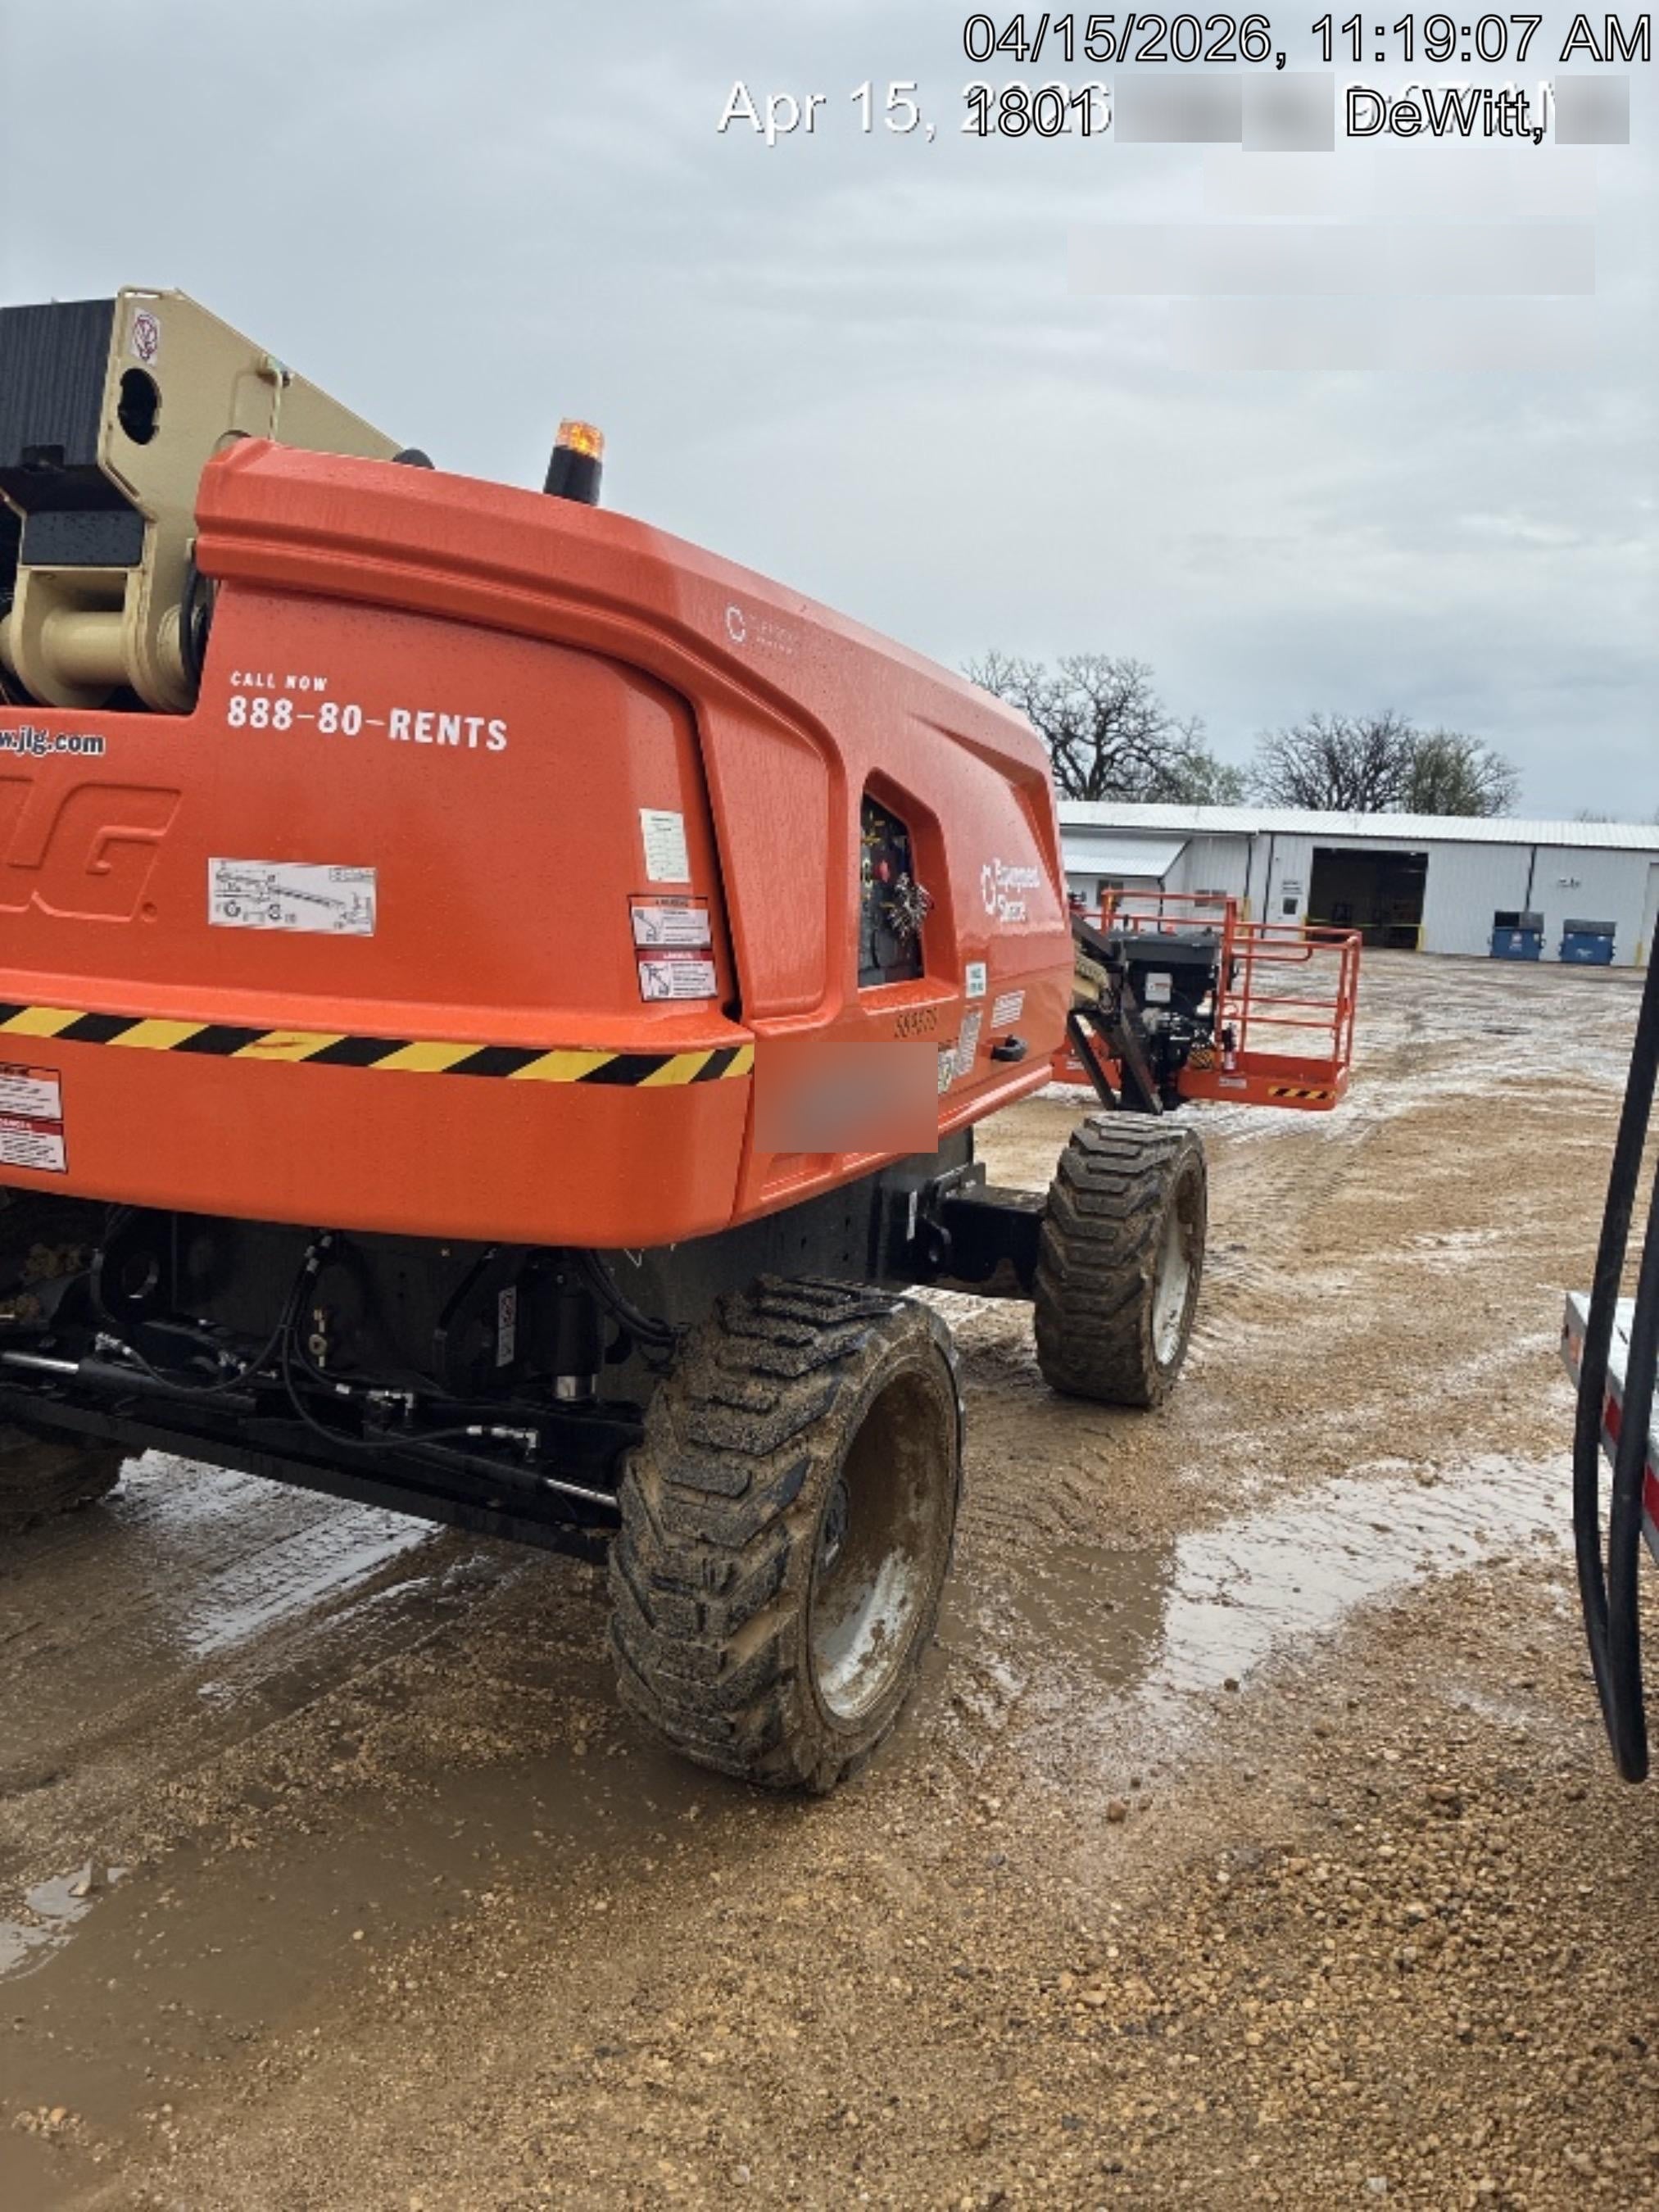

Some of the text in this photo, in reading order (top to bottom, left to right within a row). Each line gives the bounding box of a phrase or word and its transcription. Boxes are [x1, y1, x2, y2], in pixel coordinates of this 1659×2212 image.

[230, 670, 328, 692] CALL NOW
[228, 695, 507, 751] 888-80-RENTS
